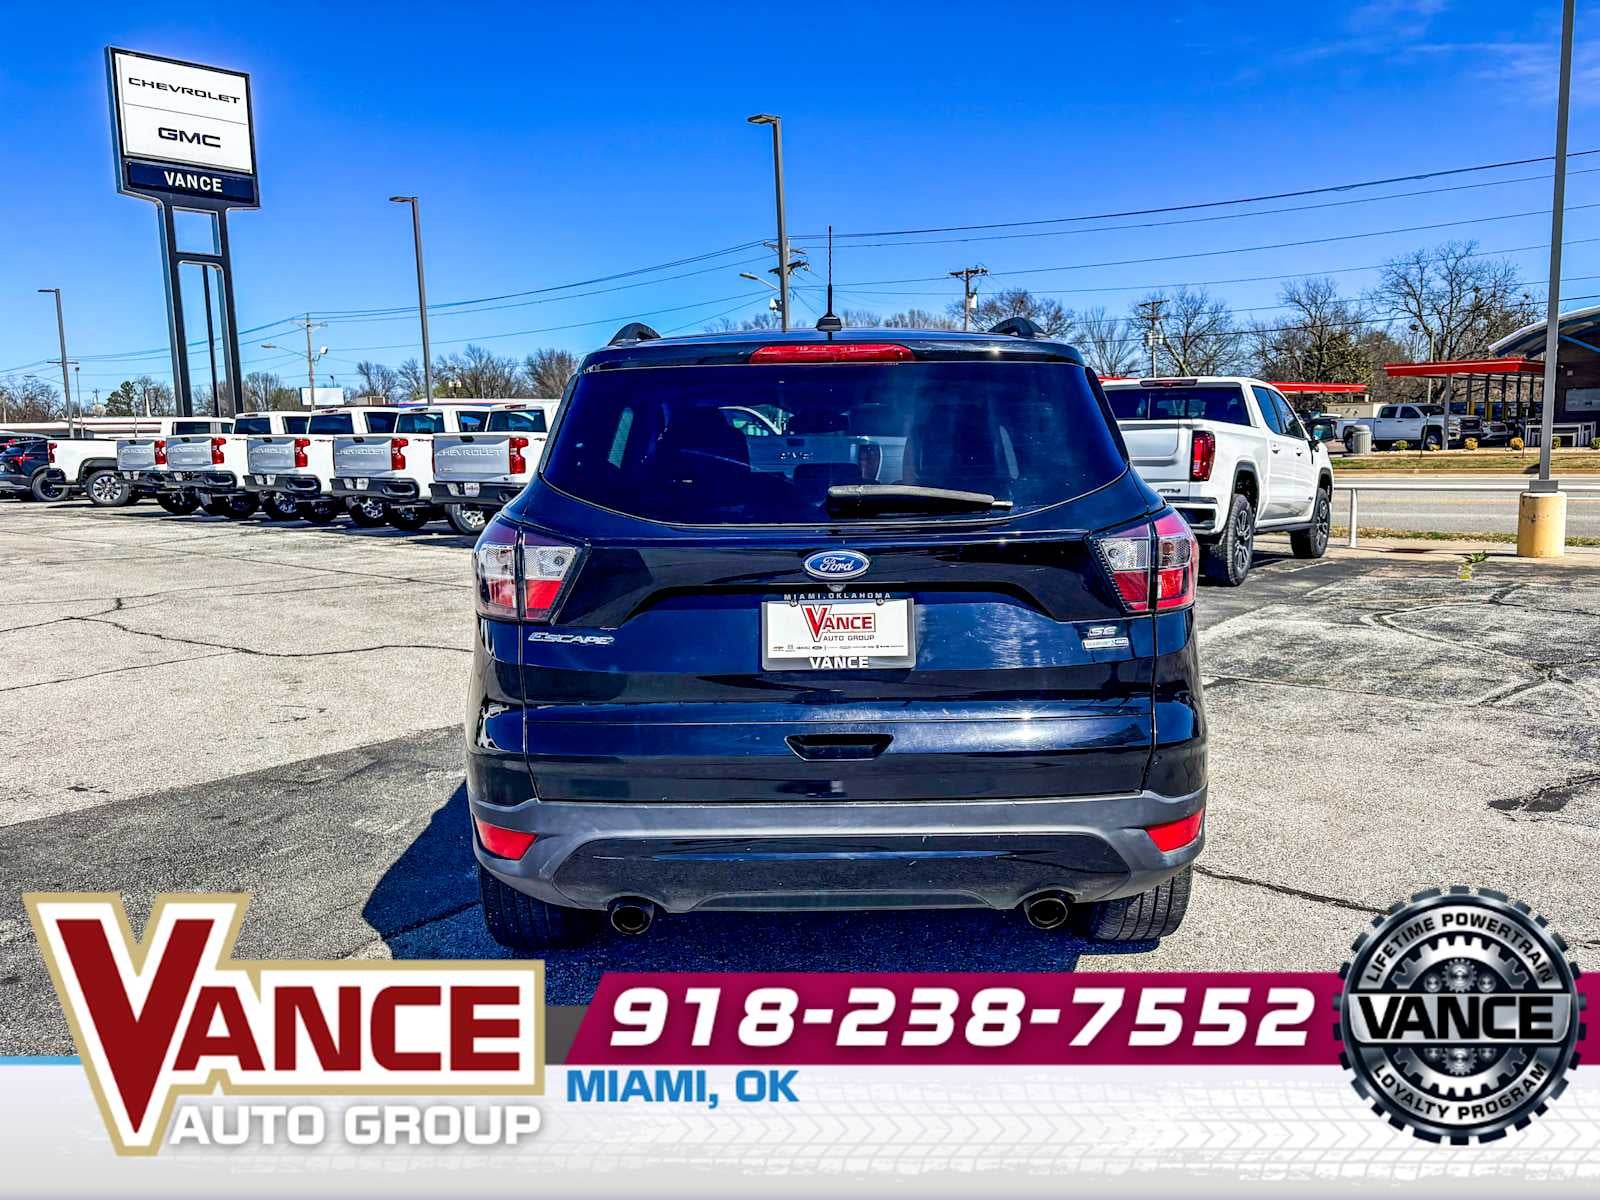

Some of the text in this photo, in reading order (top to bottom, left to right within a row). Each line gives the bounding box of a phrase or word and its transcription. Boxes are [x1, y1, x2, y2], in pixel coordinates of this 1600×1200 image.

[128, 77, 241, 104] CHEVROLET
[157, 127, 222, 148] GMC
[163, 171, 223, 194] VANCE
[436, 448, 505, 457] CHEVROLET
[819, 556, 854, 572] Ford
[828, 592, 891, 600] OKLAHOMA
[805, 607, 872, 639] VANCE
[528, 632, 615, 645] ESCAPE
[809, 656, 869, 669] VANCE
